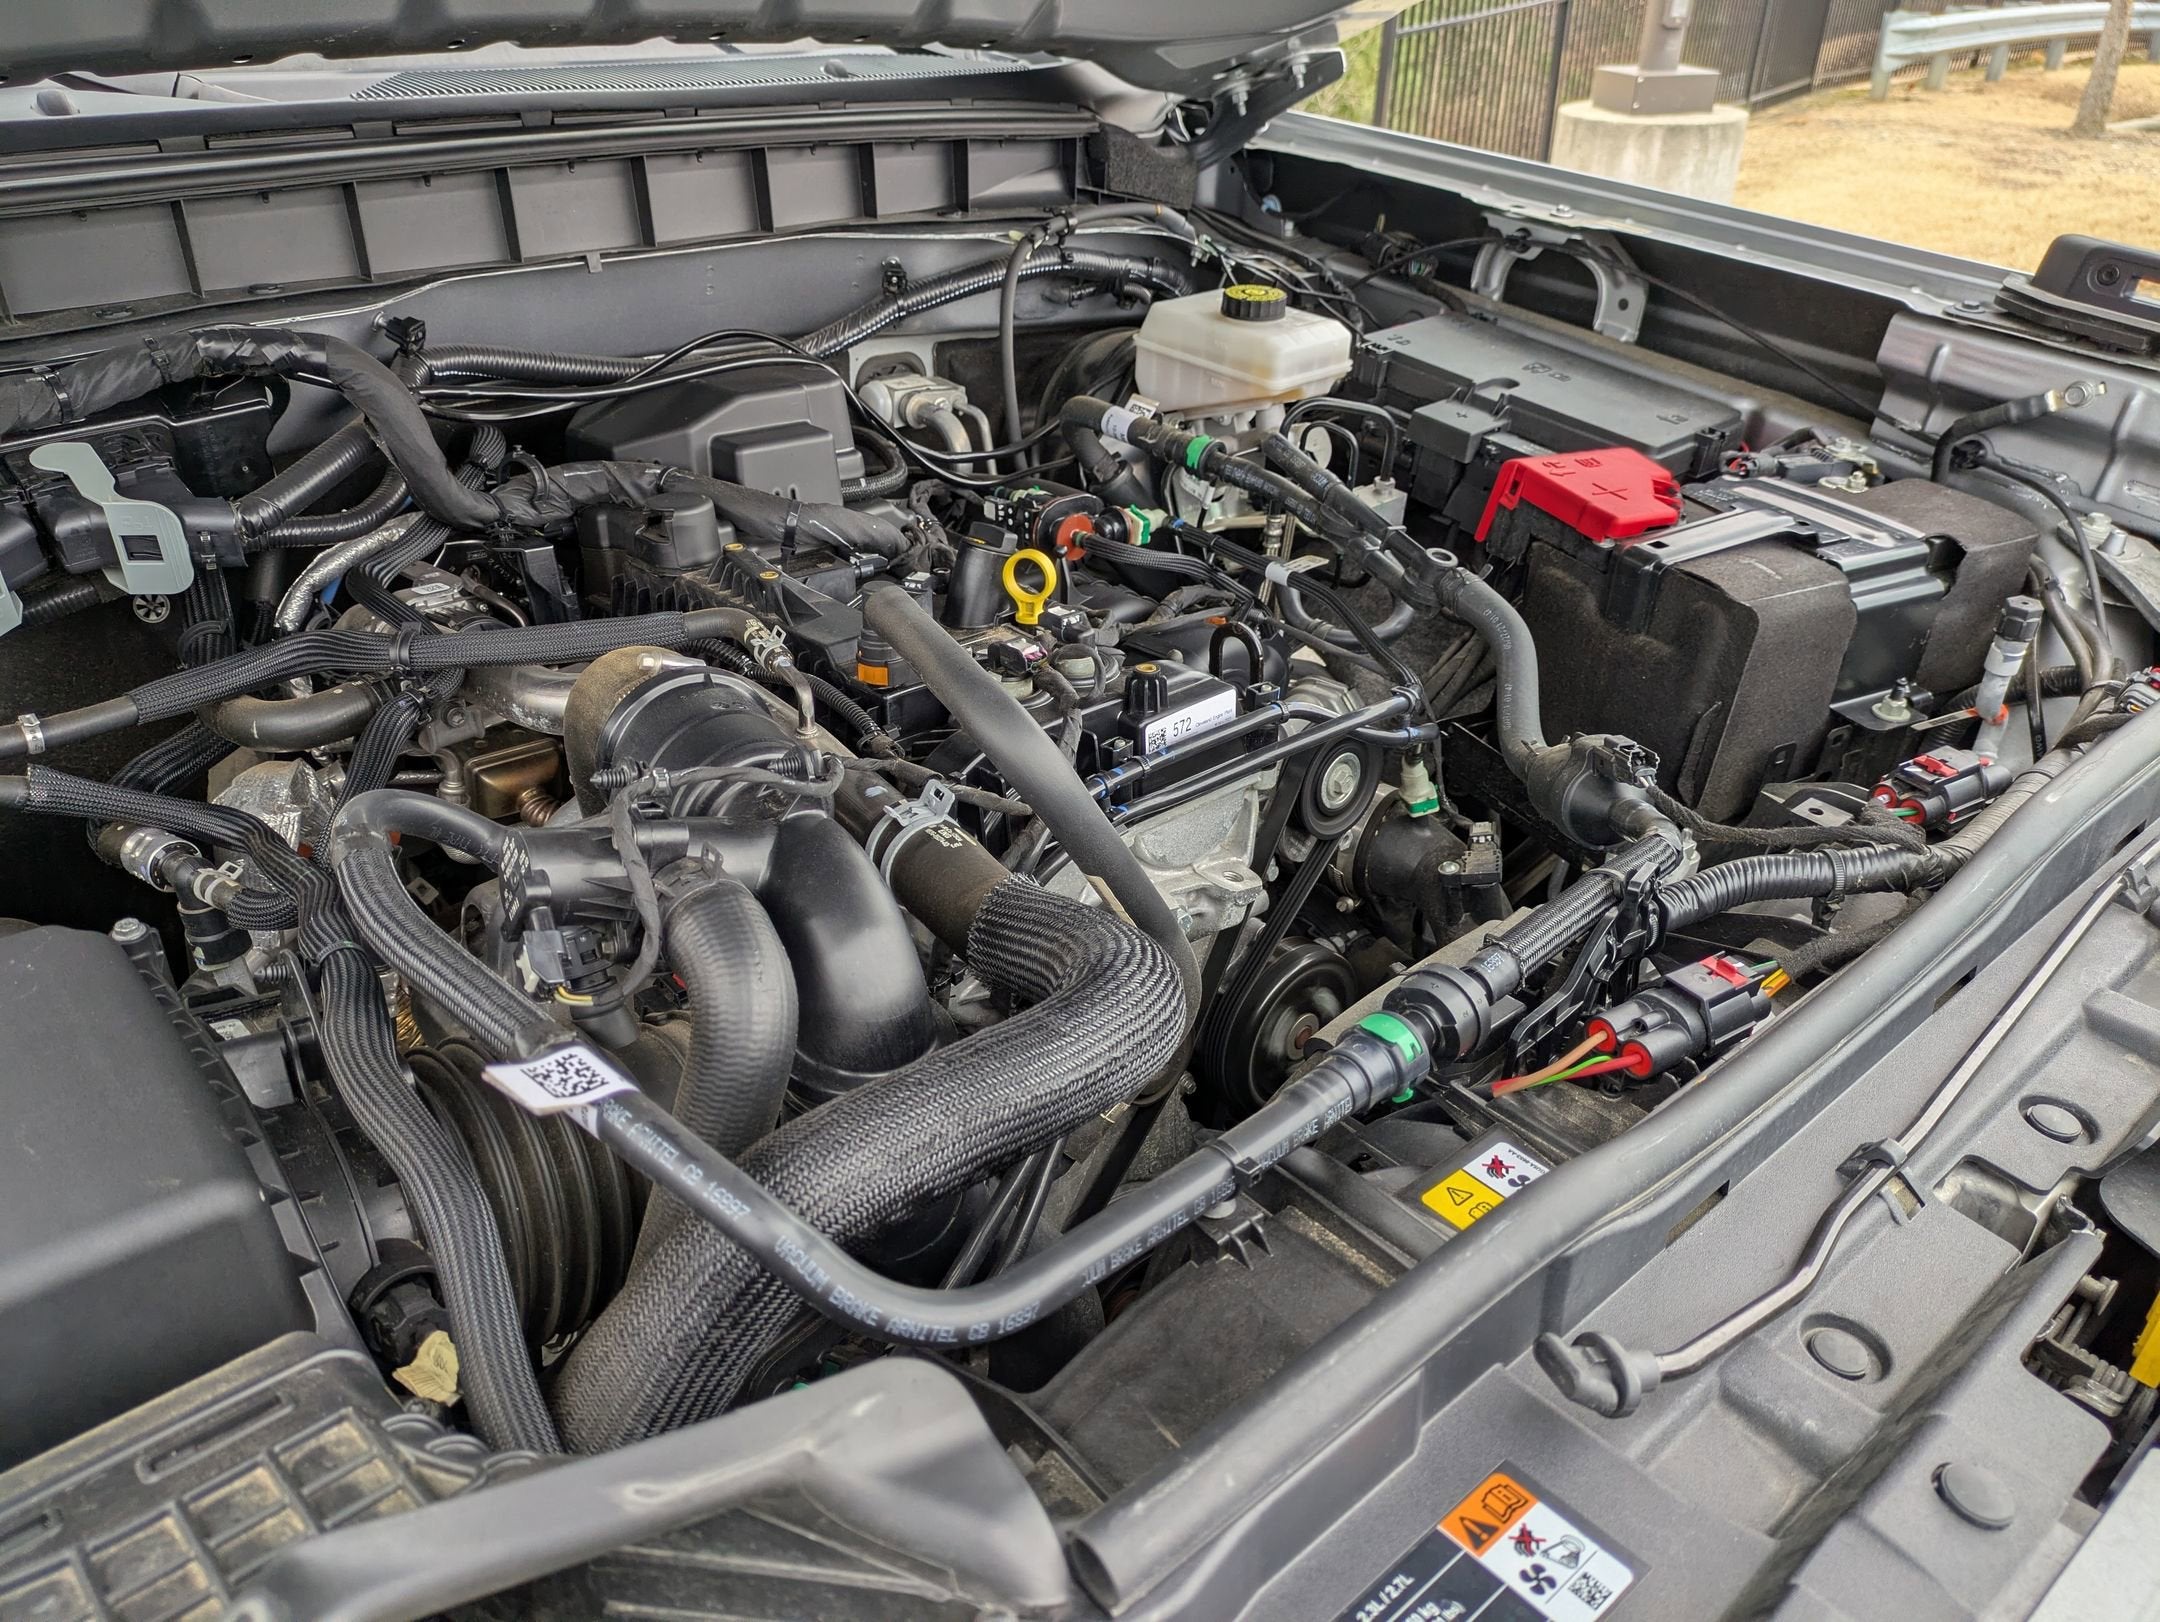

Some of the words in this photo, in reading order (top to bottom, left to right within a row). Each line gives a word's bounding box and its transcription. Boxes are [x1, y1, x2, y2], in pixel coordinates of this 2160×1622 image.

[1173, 717, 1192, 738] 572
[1293, 1118, 1319, 1148] BRAKE
[1111, 1244, 1144, 1274] BRAKE
[1148, 1209, 1190, 1247] ARNITEL
[774, 1234, 831, 1292] VACUUM
[828, 1285, 883, 1327] BRAKE
[885, 1316, 959, 1342] ARNITEL
